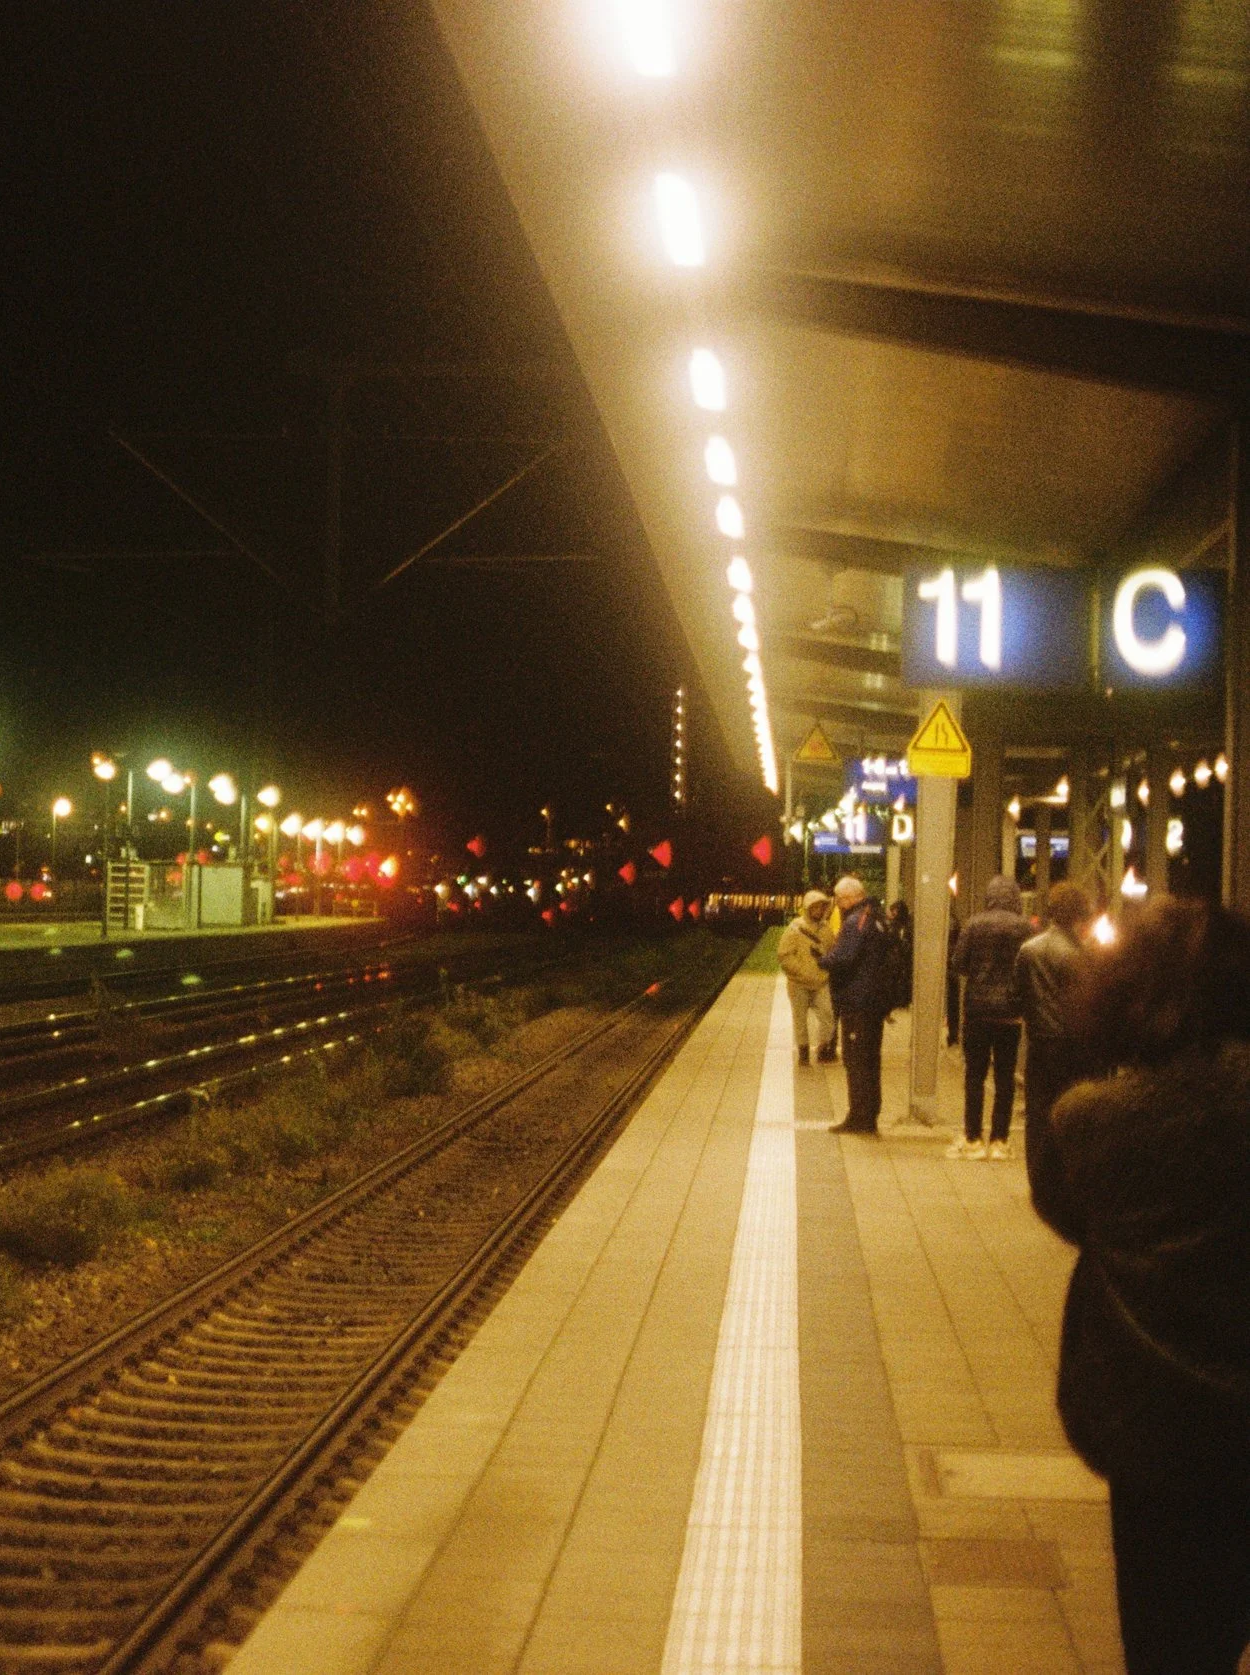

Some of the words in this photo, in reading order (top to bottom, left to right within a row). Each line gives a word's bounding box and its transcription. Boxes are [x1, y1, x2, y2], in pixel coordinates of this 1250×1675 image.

[917, 567, 1001, 670] 11
[1112, 568, 1187, 677] C
[840, 813, 867, 842] 11
[891, 813, 914, 842] D
